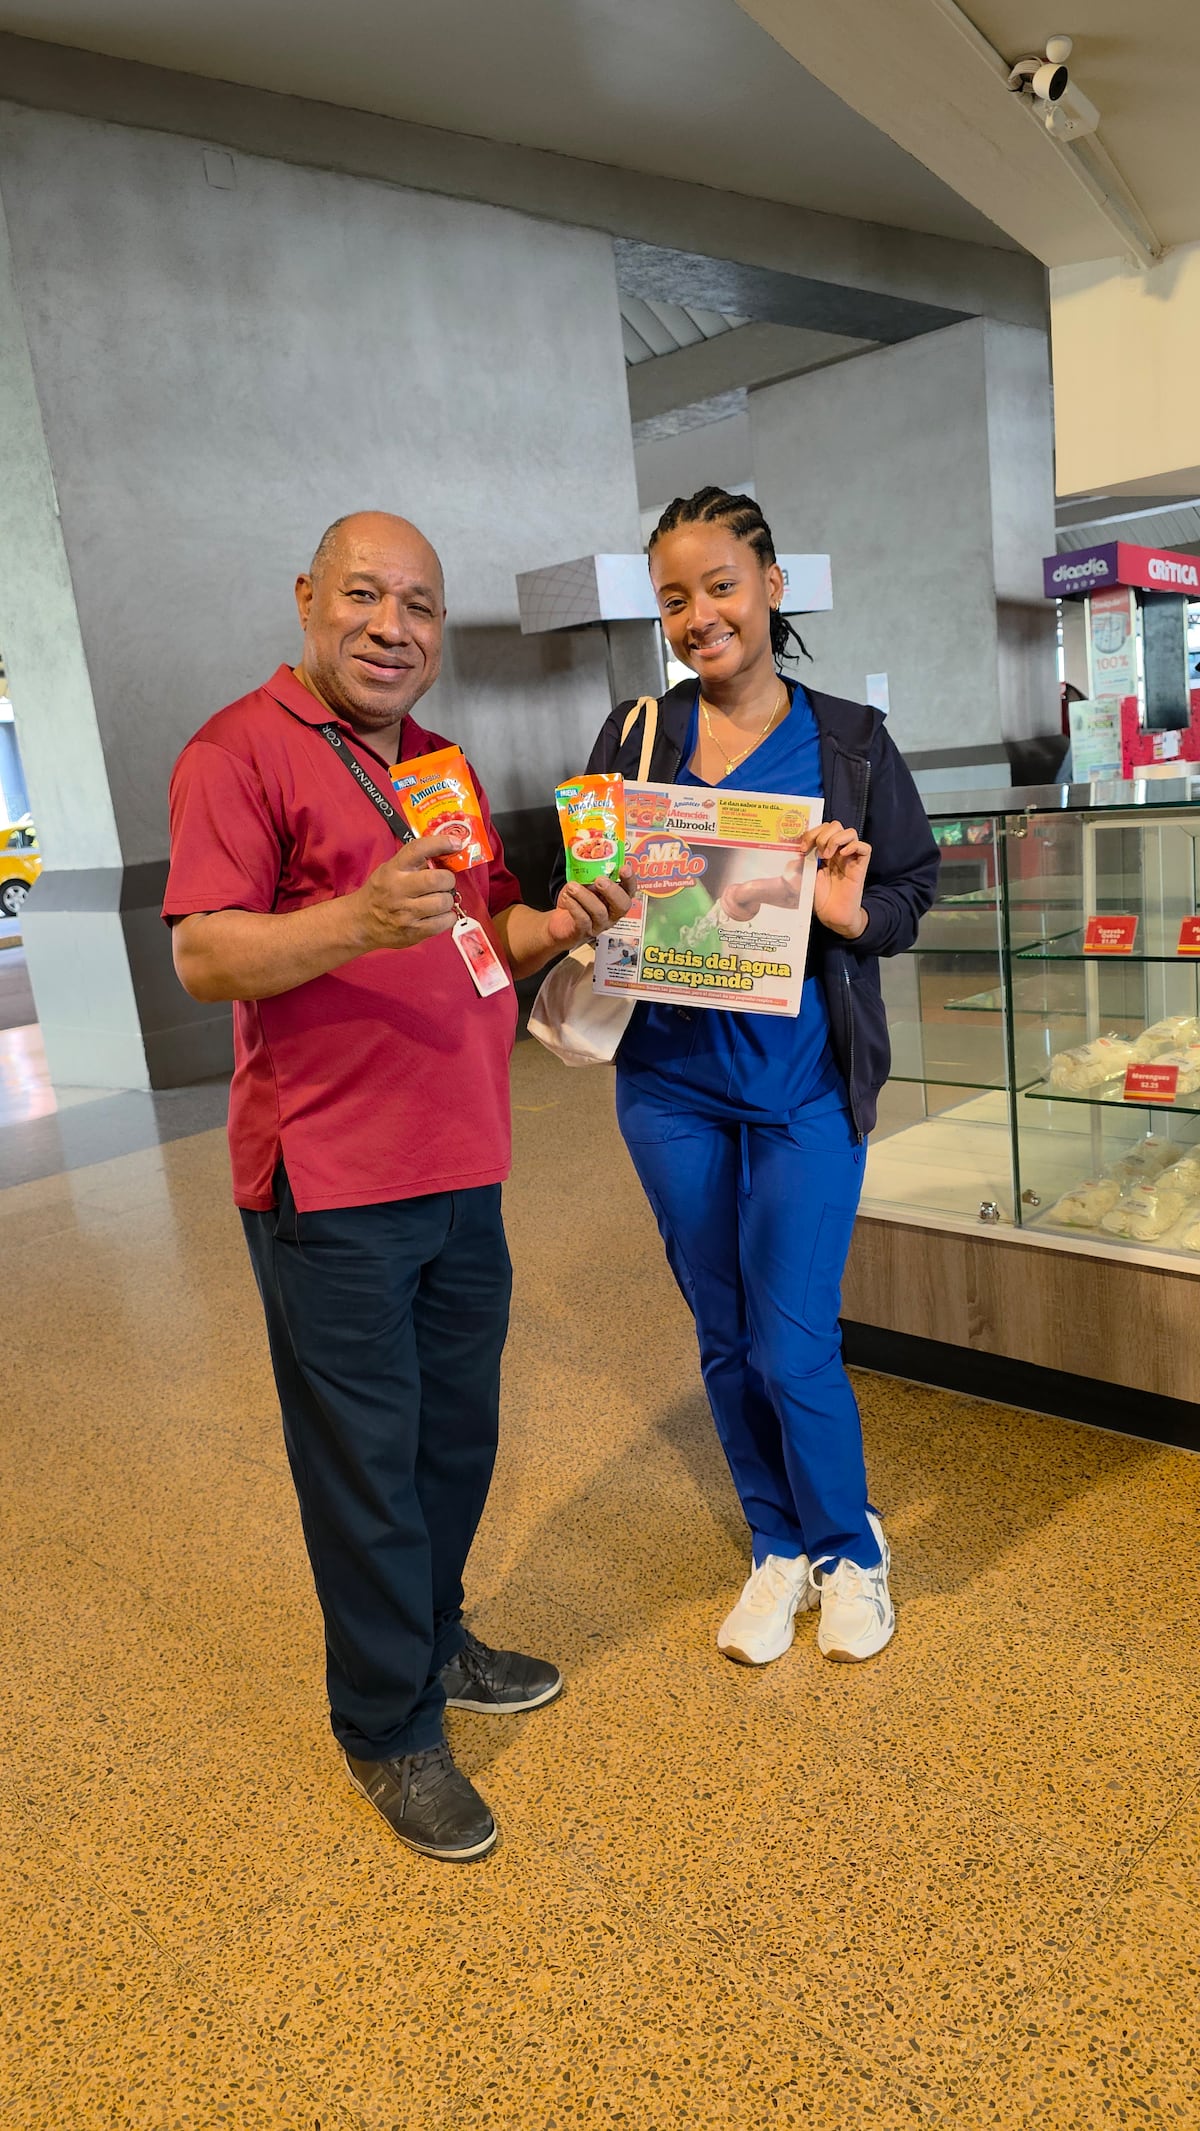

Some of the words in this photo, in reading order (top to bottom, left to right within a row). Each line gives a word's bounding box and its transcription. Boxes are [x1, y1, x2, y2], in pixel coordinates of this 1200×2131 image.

[350, 762, 394, 817] CORPRENSA
[398, 777, 416, 789] NUEVA
[410, 779, 459, 807] Amanec
[666, 818, 716, 832] Albrook!
[668, 808, 709, 820] ¡Atención
[648, 842, 681, 863] Mi
[624, 851, 705, 878] Diario
[653, 880, 662, 888] de
[643, 945, 704, 968] Crisis
[705, 952, 738, 971] del
[739, 959, 792, 978] agua
[642, 966, 665, 980] se
[667, 969, 753, 990] expande
